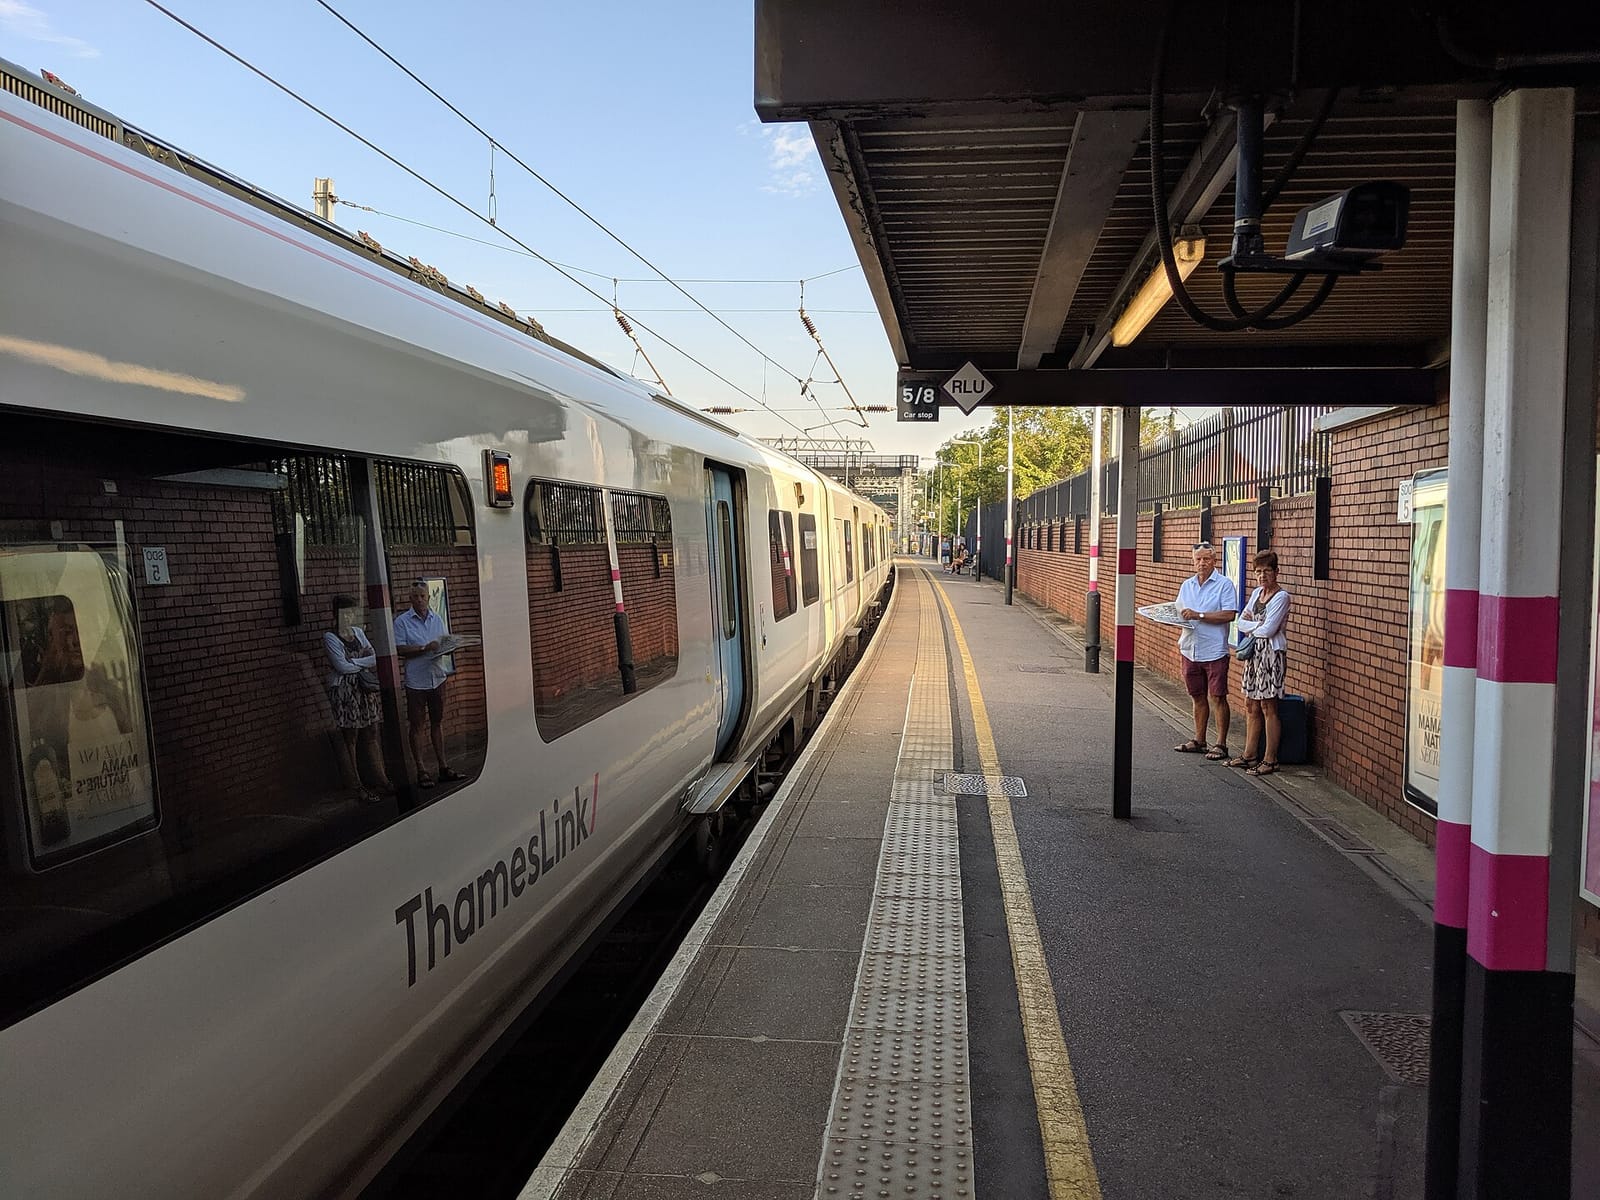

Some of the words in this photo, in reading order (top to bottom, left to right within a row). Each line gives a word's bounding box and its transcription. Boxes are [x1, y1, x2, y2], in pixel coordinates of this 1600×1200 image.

[902, 387, 935, 404] 5/8
[952, 380, 984, 394] RLU
[918, 411, 933, 420] stop
[1404, 500, 1409, 519] 5
[1424, 731, 1440, 750] NAT
[395, 786, 589, 988] ThamesLink
